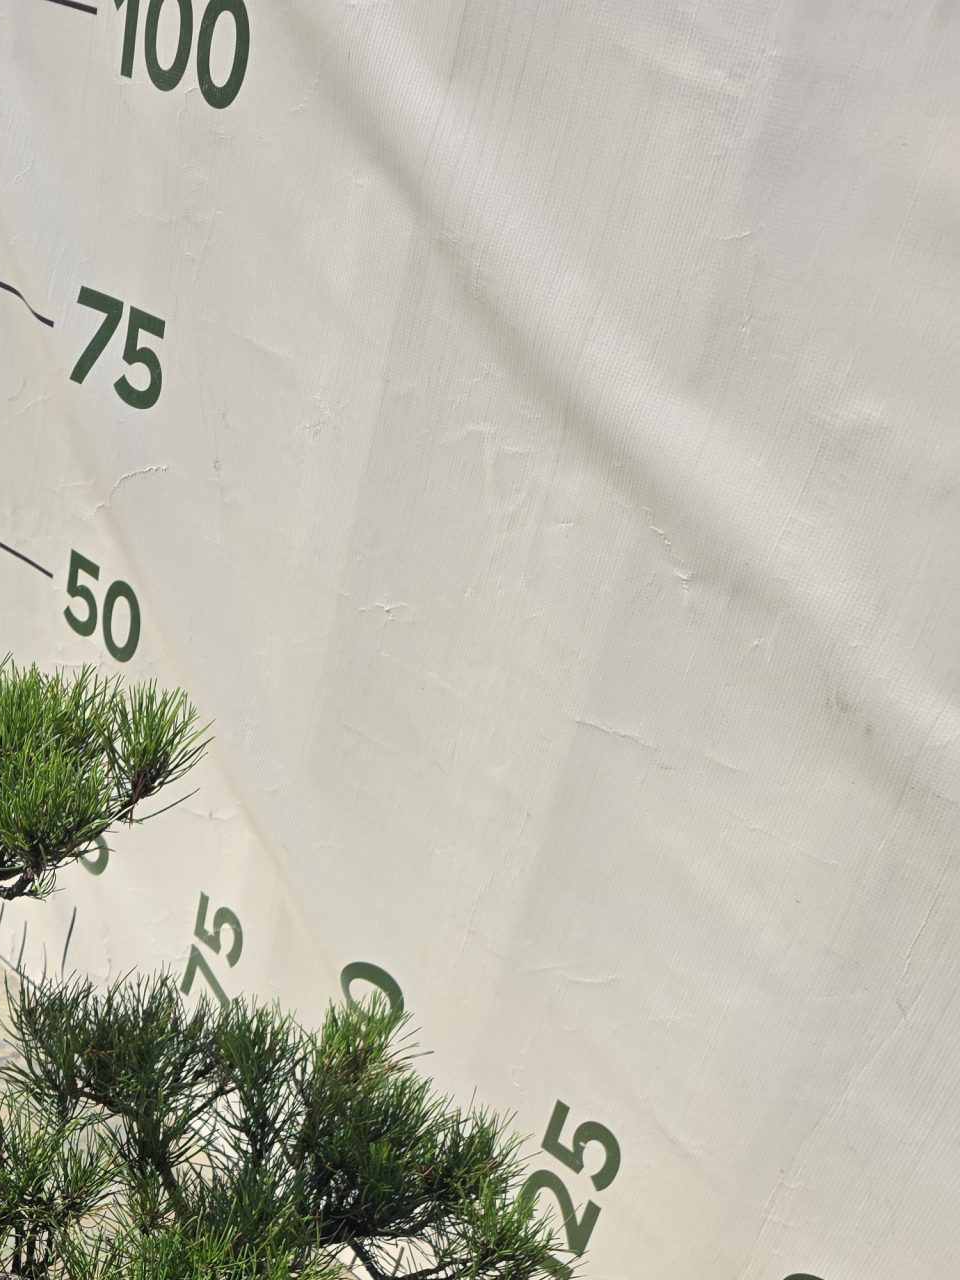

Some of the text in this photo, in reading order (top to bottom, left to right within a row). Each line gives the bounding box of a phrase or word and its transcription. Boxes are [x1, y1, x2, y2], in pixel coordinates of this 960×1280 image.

[114, 0, 250, 109] 100
[69, 285, 166, 410] 75
[63, 548, 141, 663] 50
[179, 890, 244, 1014] 75
